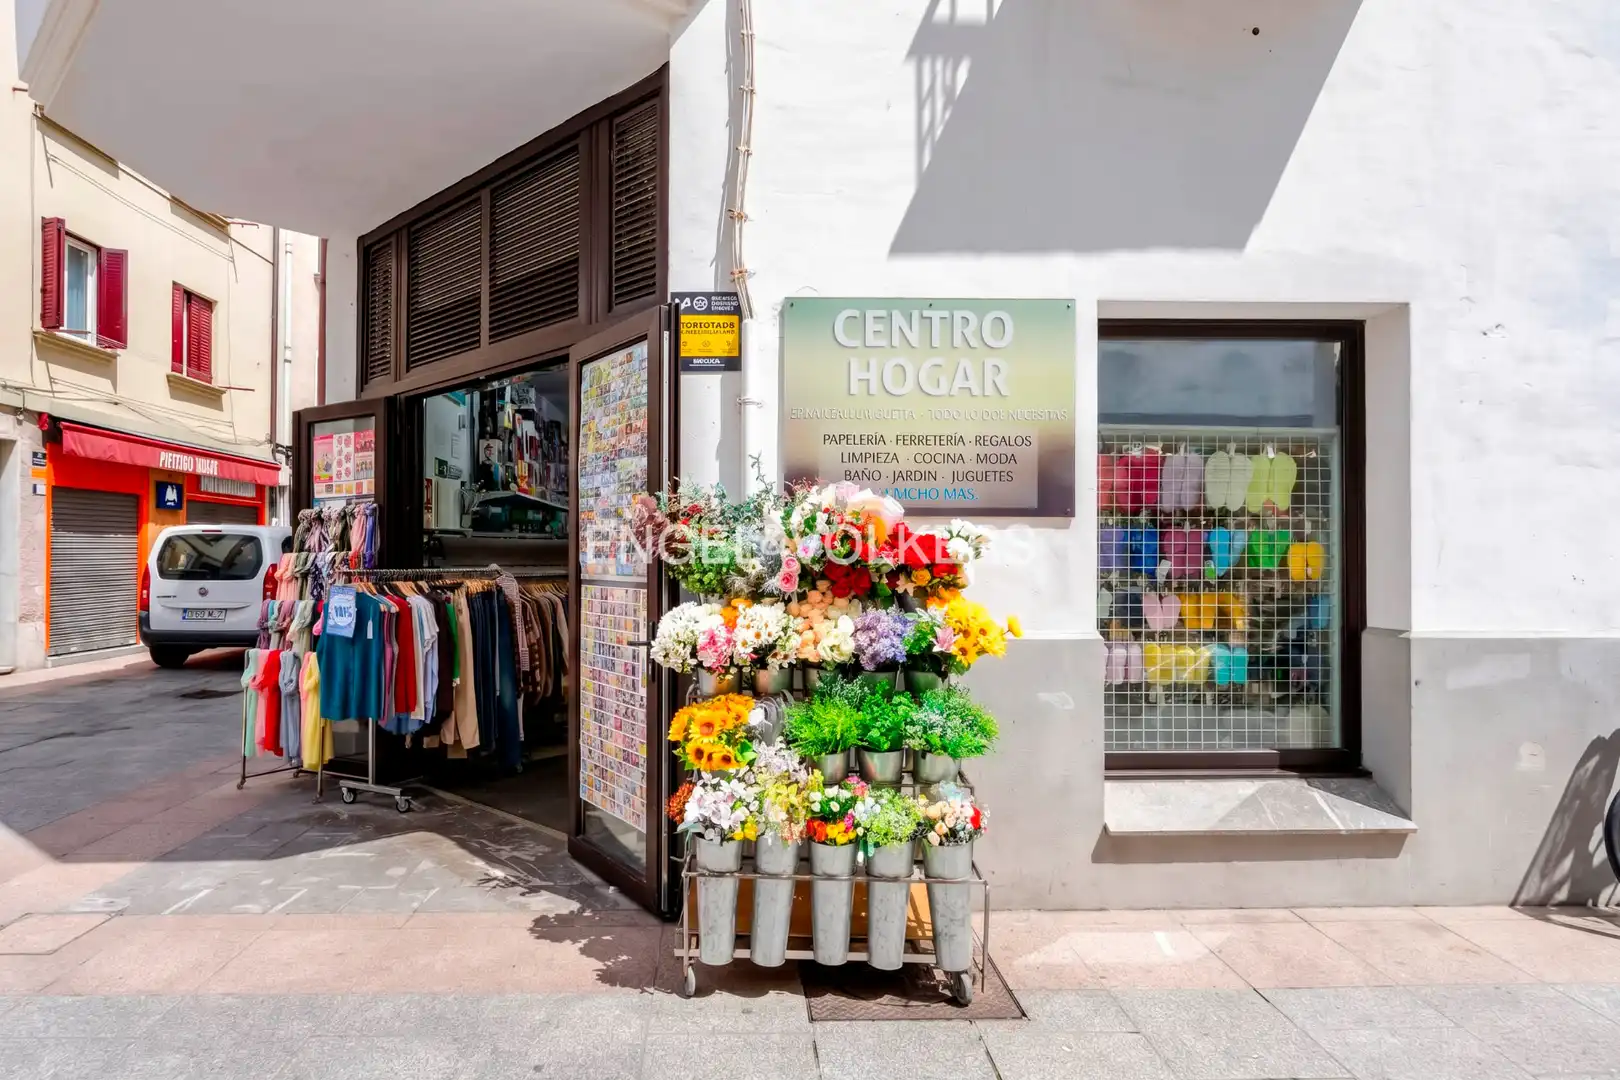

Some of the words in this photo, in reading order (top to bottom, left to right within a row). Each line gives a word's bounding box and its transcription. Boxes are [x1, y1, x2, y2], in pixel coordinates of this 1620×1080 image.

[833, 308, 1015, 350] CENTRO
[847, 356, 1010, 397] HOGAR
[822, 432, 887, 446] PAPELERÍA
[895, 432, 966, 446] FERRETERÍA
[974, 435, 1032, 447] REGALOS
[840, 452, 900, 464] LIMPIEZA
[913, 452, 965, 464] COCINA
[976, 453, 1018, 465] MODA
[843, 467, 882, 482] BAÑO
[891, 470, 938, 484] JARDIN
[950, 470, 1014, 483] JUGUETES
